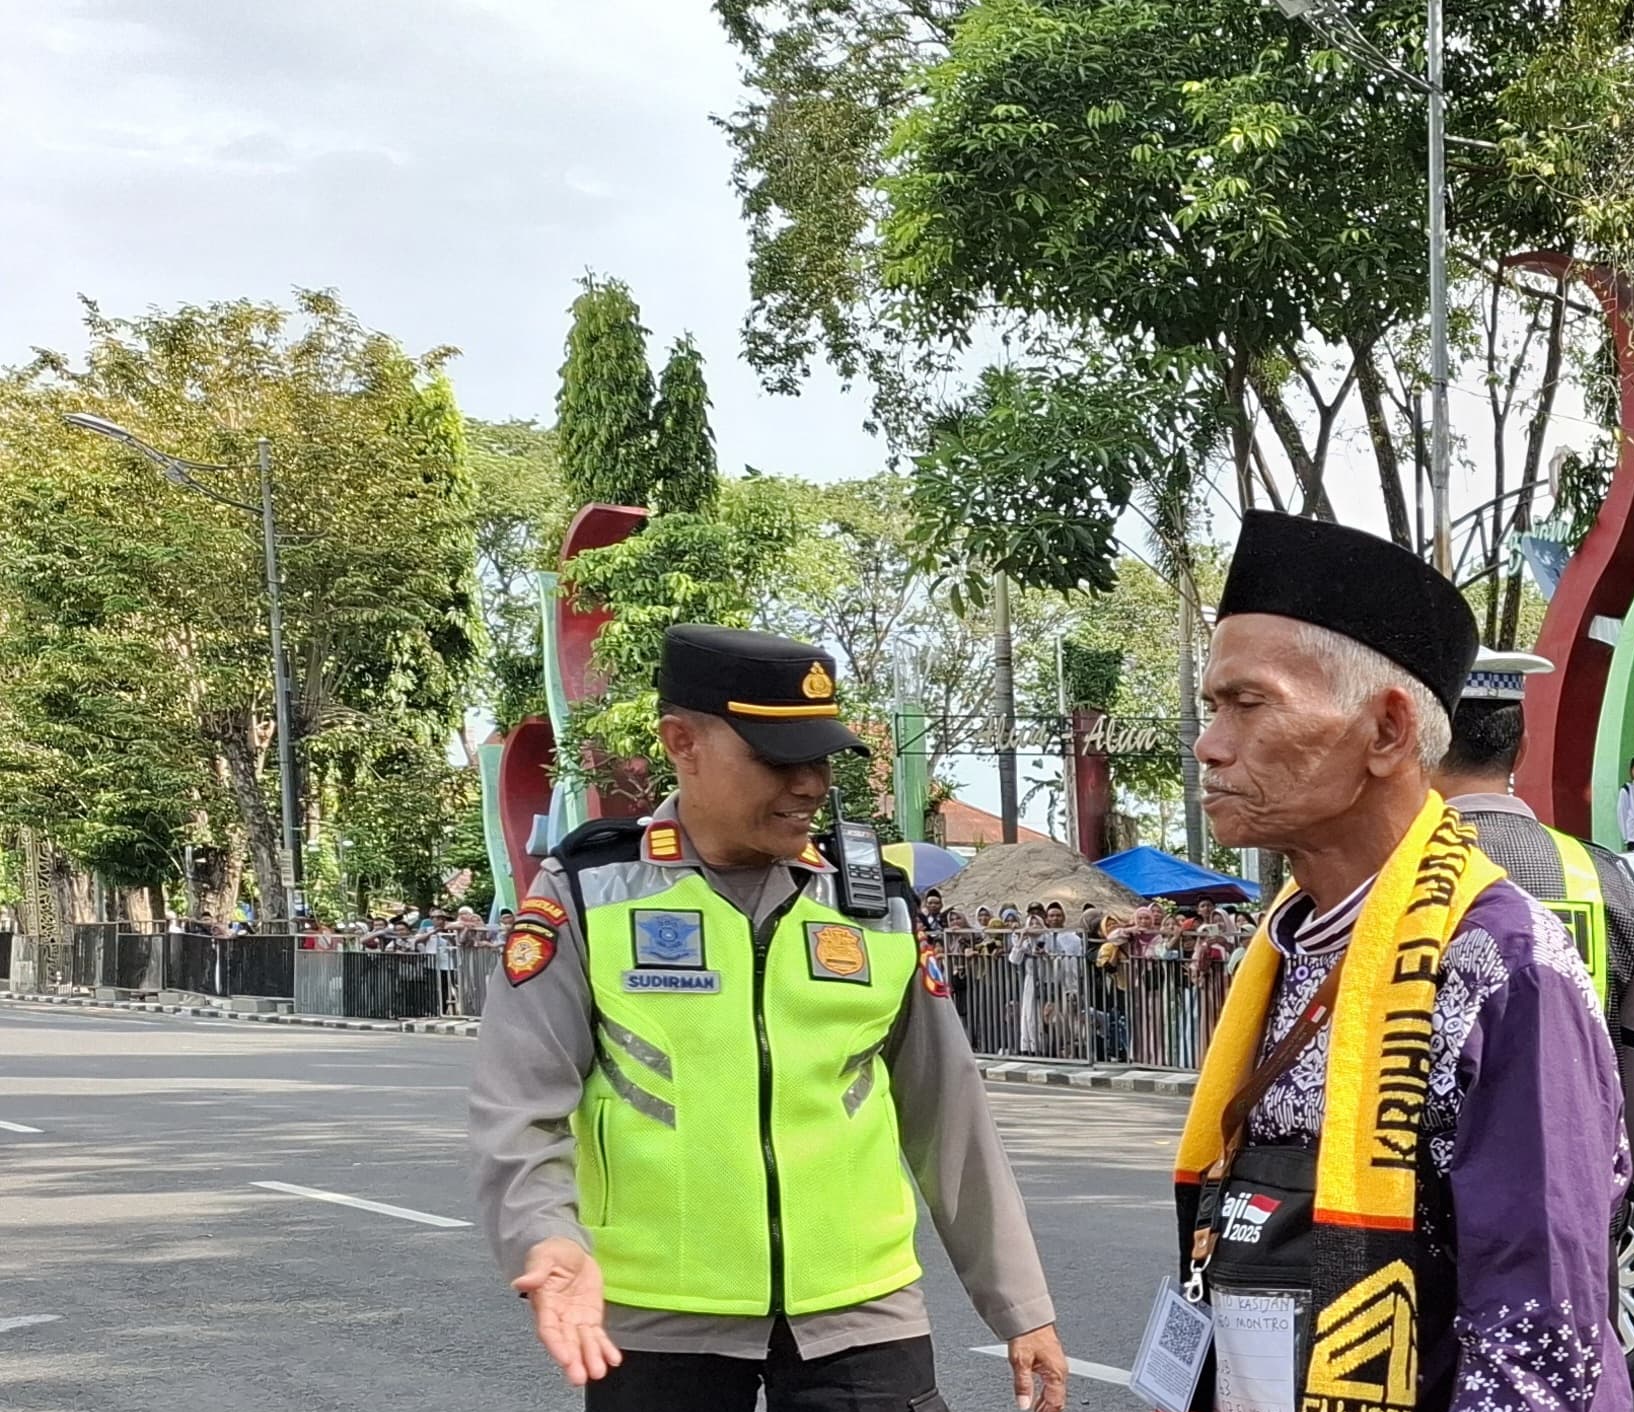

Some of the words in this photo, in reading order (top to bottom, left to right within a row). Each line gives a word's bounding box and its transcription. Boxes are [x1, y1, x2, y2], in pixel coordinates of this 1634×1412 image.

[1081, 713, 1157, 757] Alun
[627, 974, 715, 990] SUDIRMAN
[1221, 1191, 1253, 1239] aji
[1228, 1223, 1264, 1244] 2025
